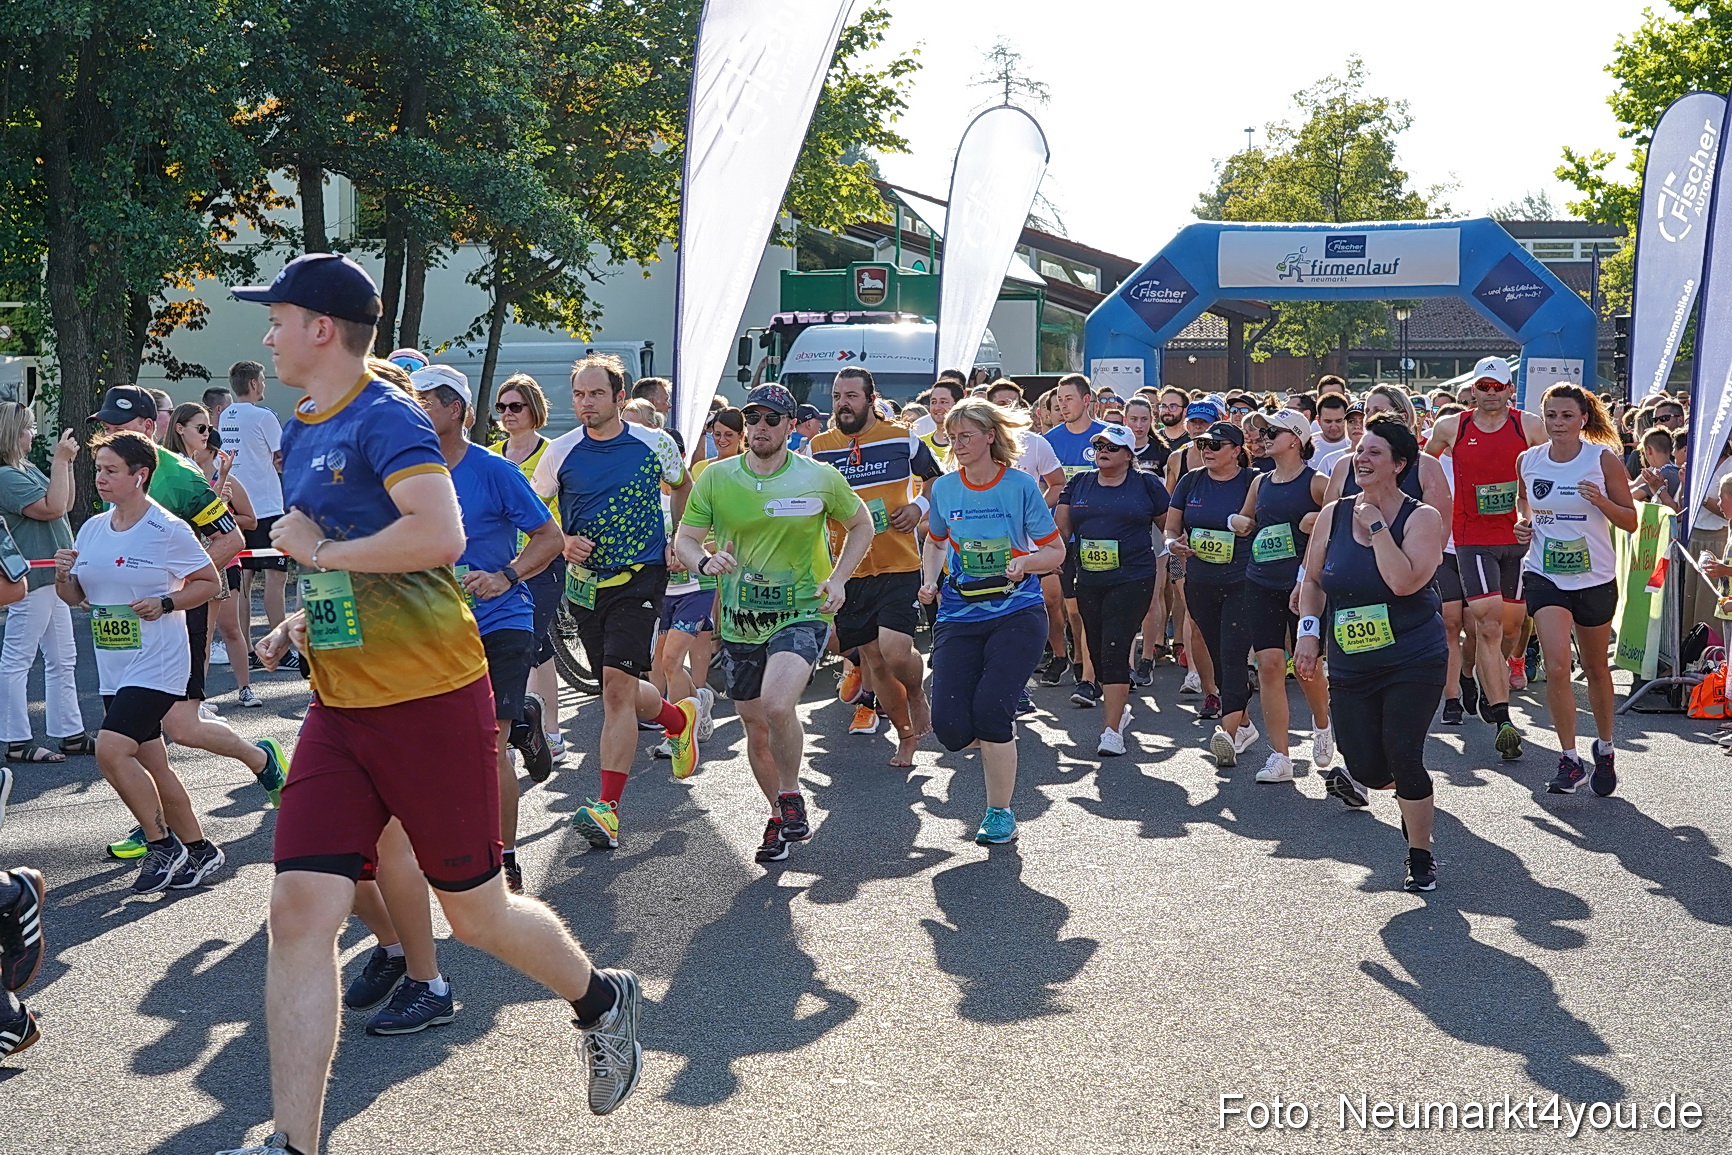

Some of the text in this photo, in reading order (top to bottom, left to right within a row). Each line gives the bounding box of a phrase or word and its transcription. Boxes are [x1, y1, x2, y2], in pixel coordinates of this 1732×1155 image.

[1671, 118, 1717, 223] Fischer
[1334, 243, 1364, 251] Fischer
[1311, 257, 1400, 276] firmenlauf
[1139, 281, 1188, 299] Fischer
[1649, 278, 1695, 395] fischer-automobile.de
[795, 350, 835, 362] abavent
[1187, 405, 1215, 416] adidas
[838, 460, 889, 475] Fischer
[1484, 492, 1515, 506] 1313
[965, 507, 1000, 515] Raiffeisenbank
[1200, 540, 1223, 554] 492
[1260, 536, 1283, 551] 493
[976, 551, 996, 565] 14
[1087, 550, 1108, 562] 483
[1550, 550, 1583, 564] 1223
[569, 575, 587, 594] 707
[740, 586, 748, 602] RUN
[751, 585, 782, 600] 145
[786, 587, 794, 606] 2022
[342, 600, 358, 636] 2022
[97, 620, 131, 636] 1488
[131, 621, 139, 644] 2022
[1347, 621, 1376, 639] 830
[1380, 621, 1392, 641] 2022
